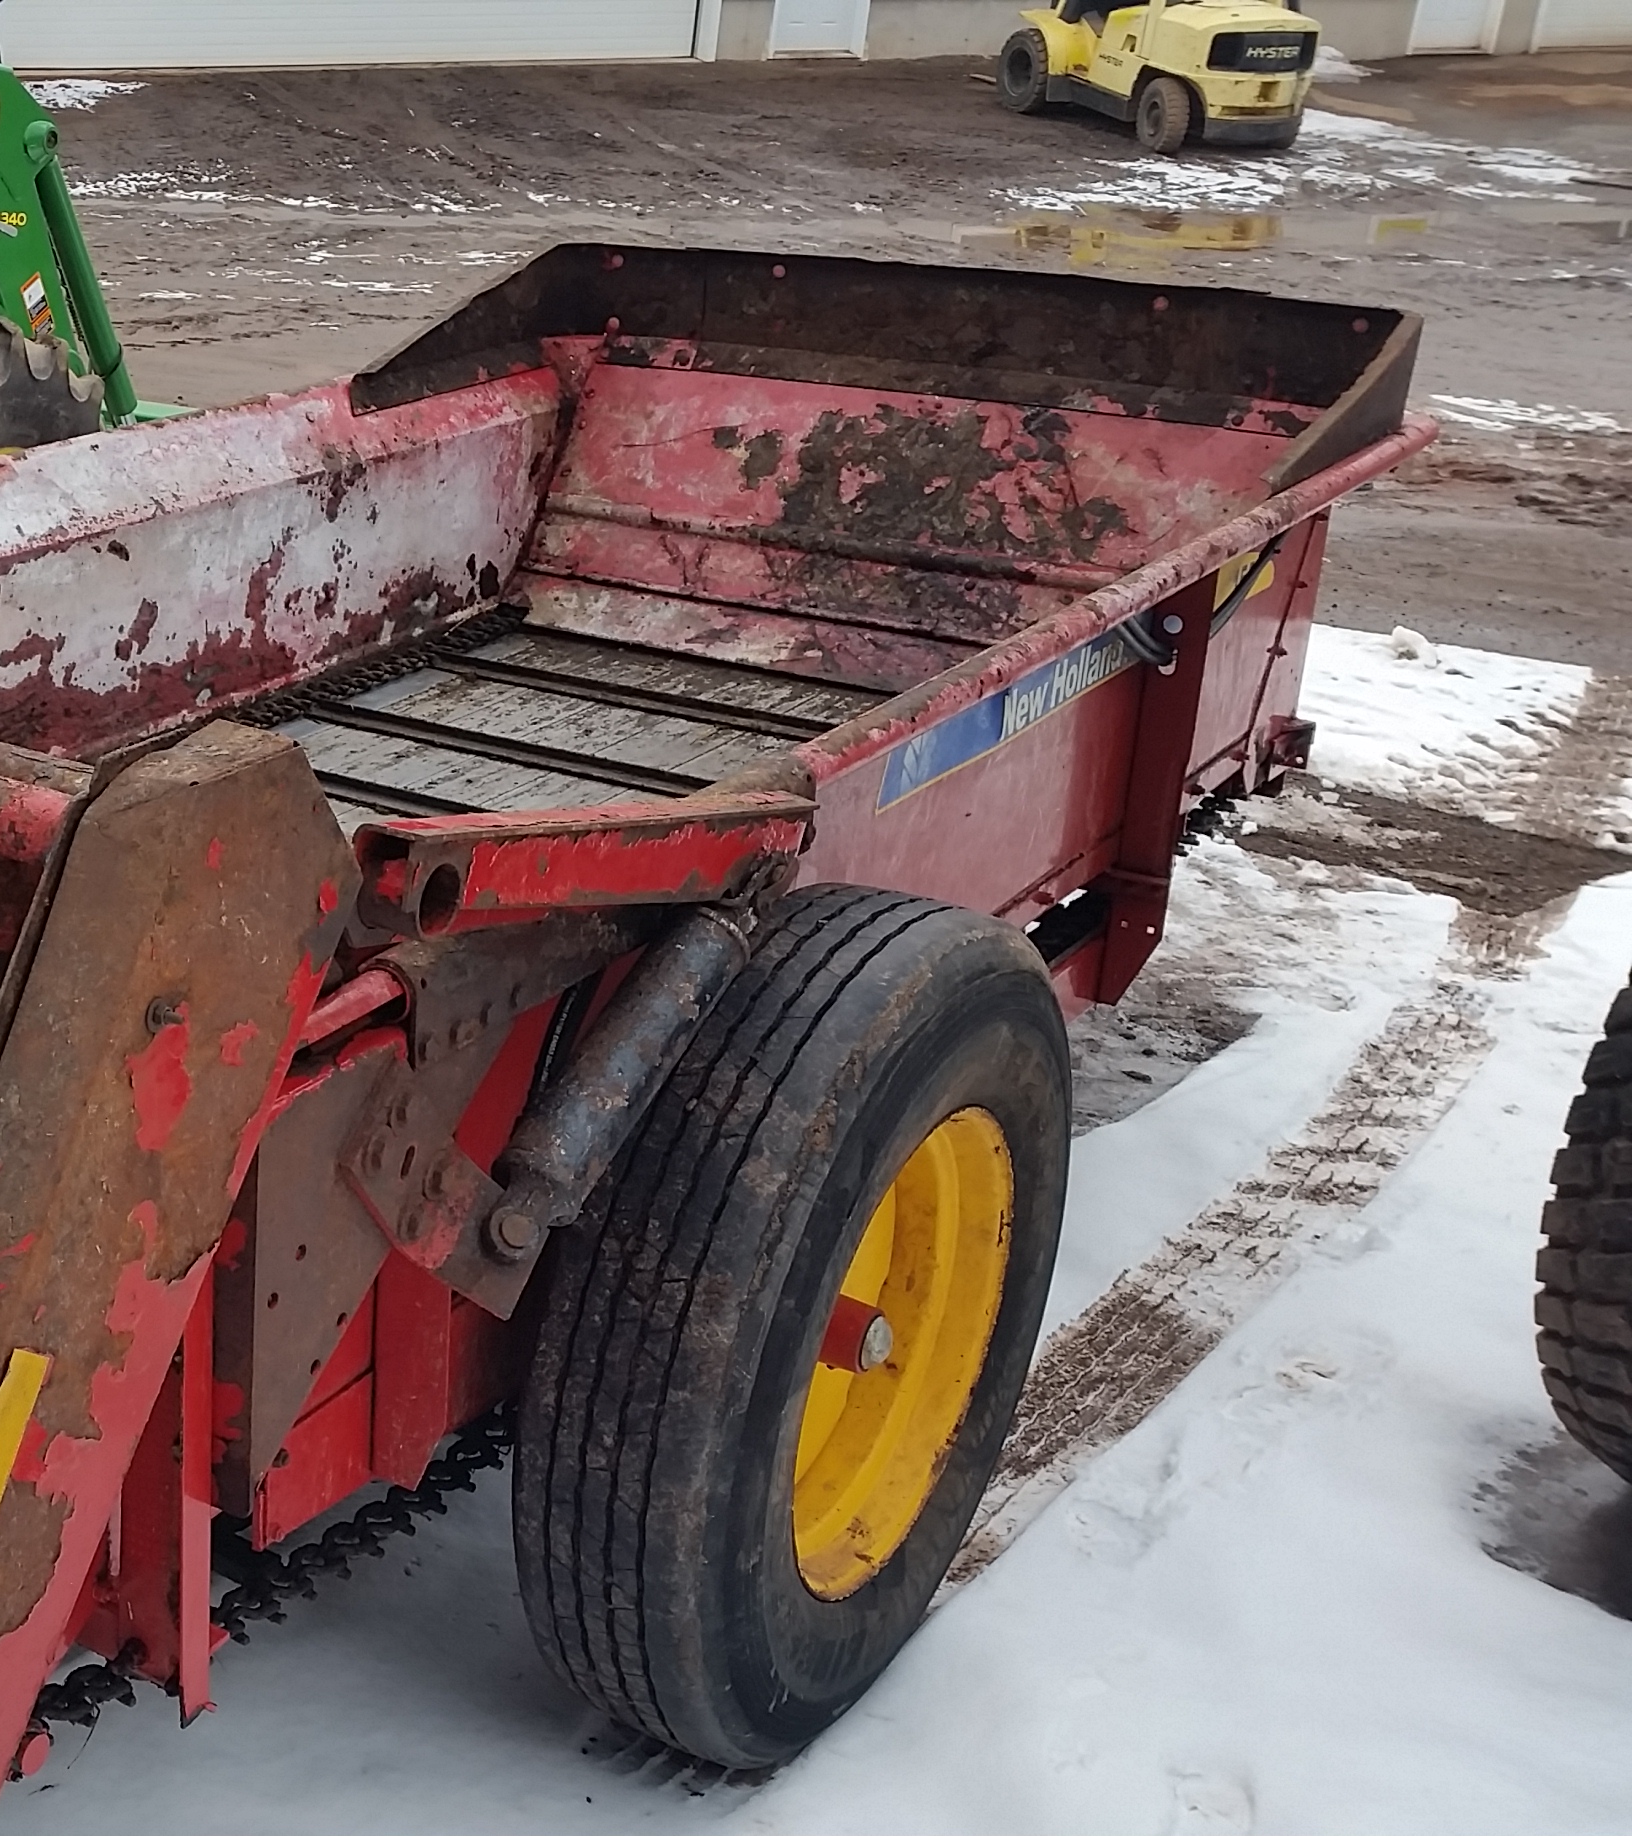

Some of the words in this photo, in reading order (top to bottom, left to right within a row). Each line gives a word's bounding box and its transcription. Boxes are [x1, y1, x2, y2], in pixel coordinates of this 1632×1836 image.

[1246, 46, 1301, 59] HYSTER
[999, 681, 1049, 742] New
[1050, 640, 1124, 709] Holland
